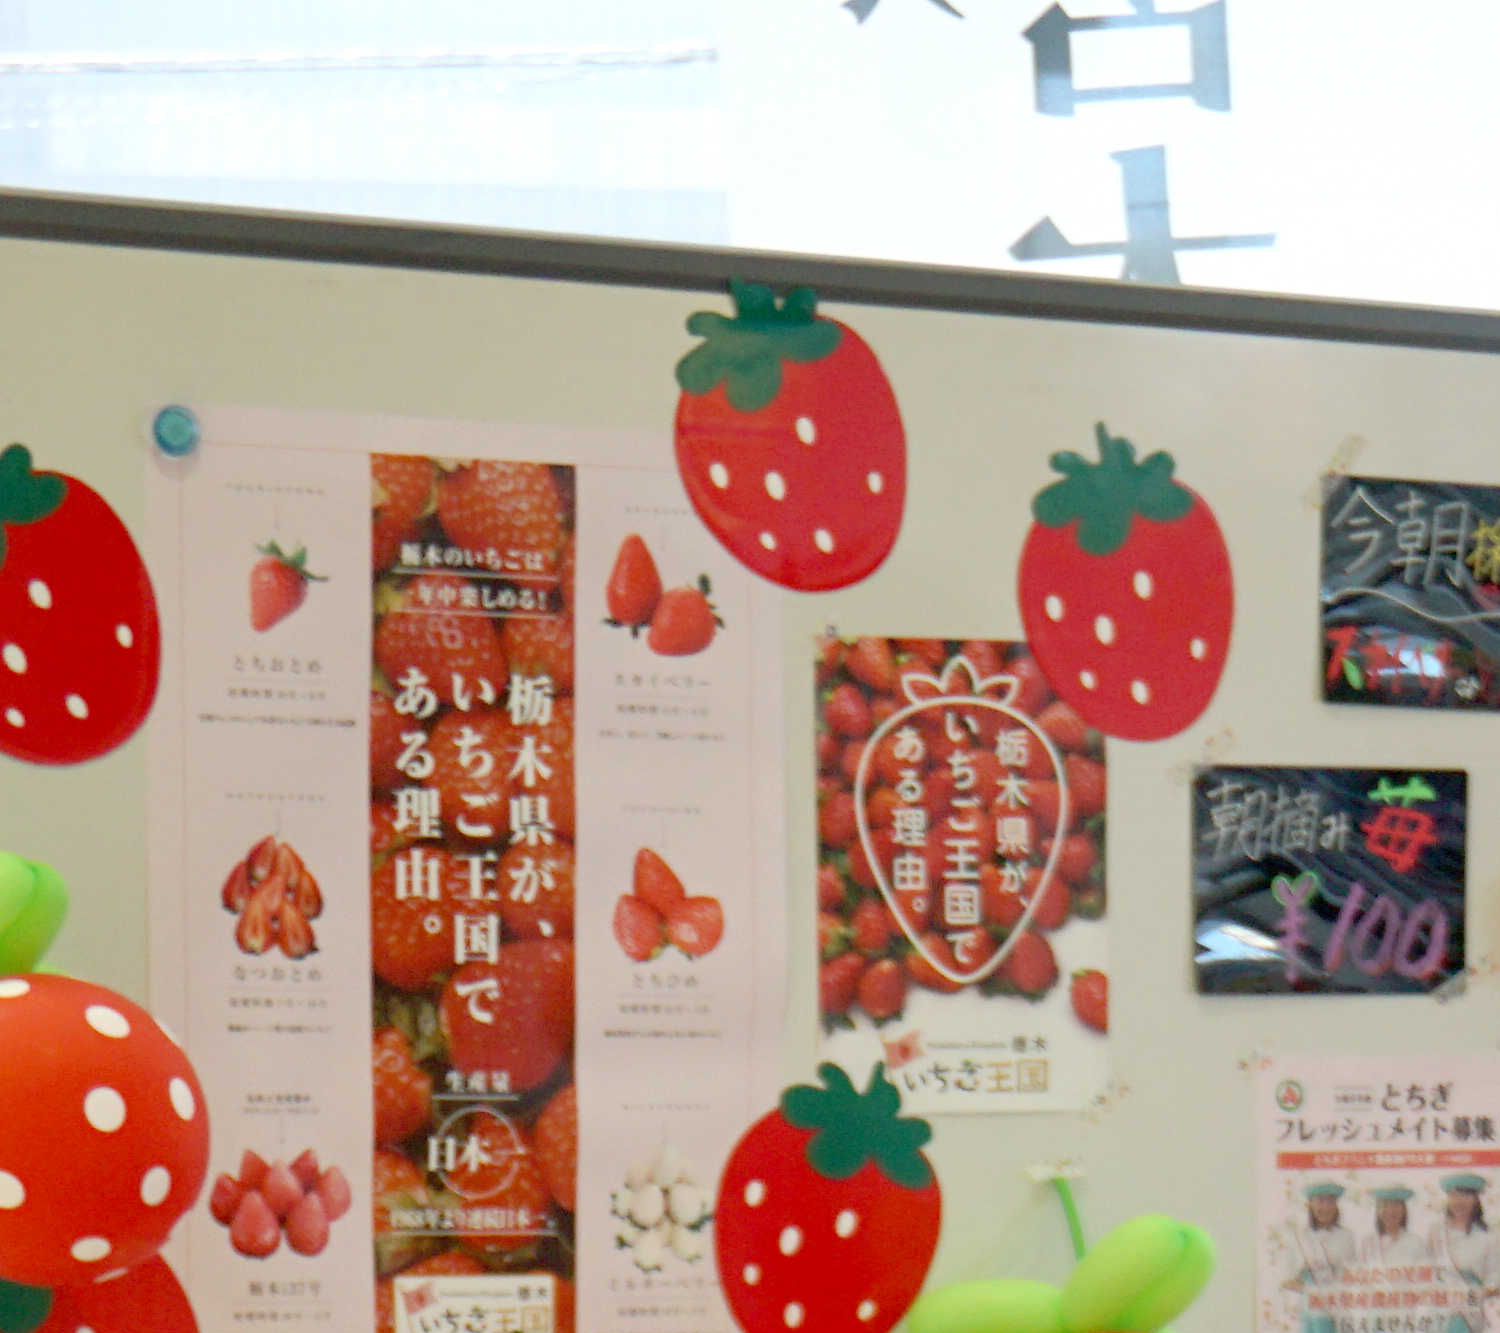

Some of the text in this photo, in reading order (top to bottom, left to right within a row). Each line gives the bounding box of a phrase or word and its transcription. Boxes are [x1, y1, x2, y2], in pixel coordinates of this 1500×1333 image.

[399, 541, 545, 570] 栃木のいちごは
[393, 666, 442, 935] ある理由。
[450, 673, 501, 1025] いちご王国で
[504, 674, 556, 938] 栃木県が、
[892, 729, 928, 914] ある理由。
[943, 709, 982, 966] いちご王国で
[994, 728, 1032, 909] 栃木県が、
[1275, 878, 1453, 982] ¥100
[902, 1058, 1050, 1093] いちご王国
[1381, 1080, 1454, 1112] とちぎ
